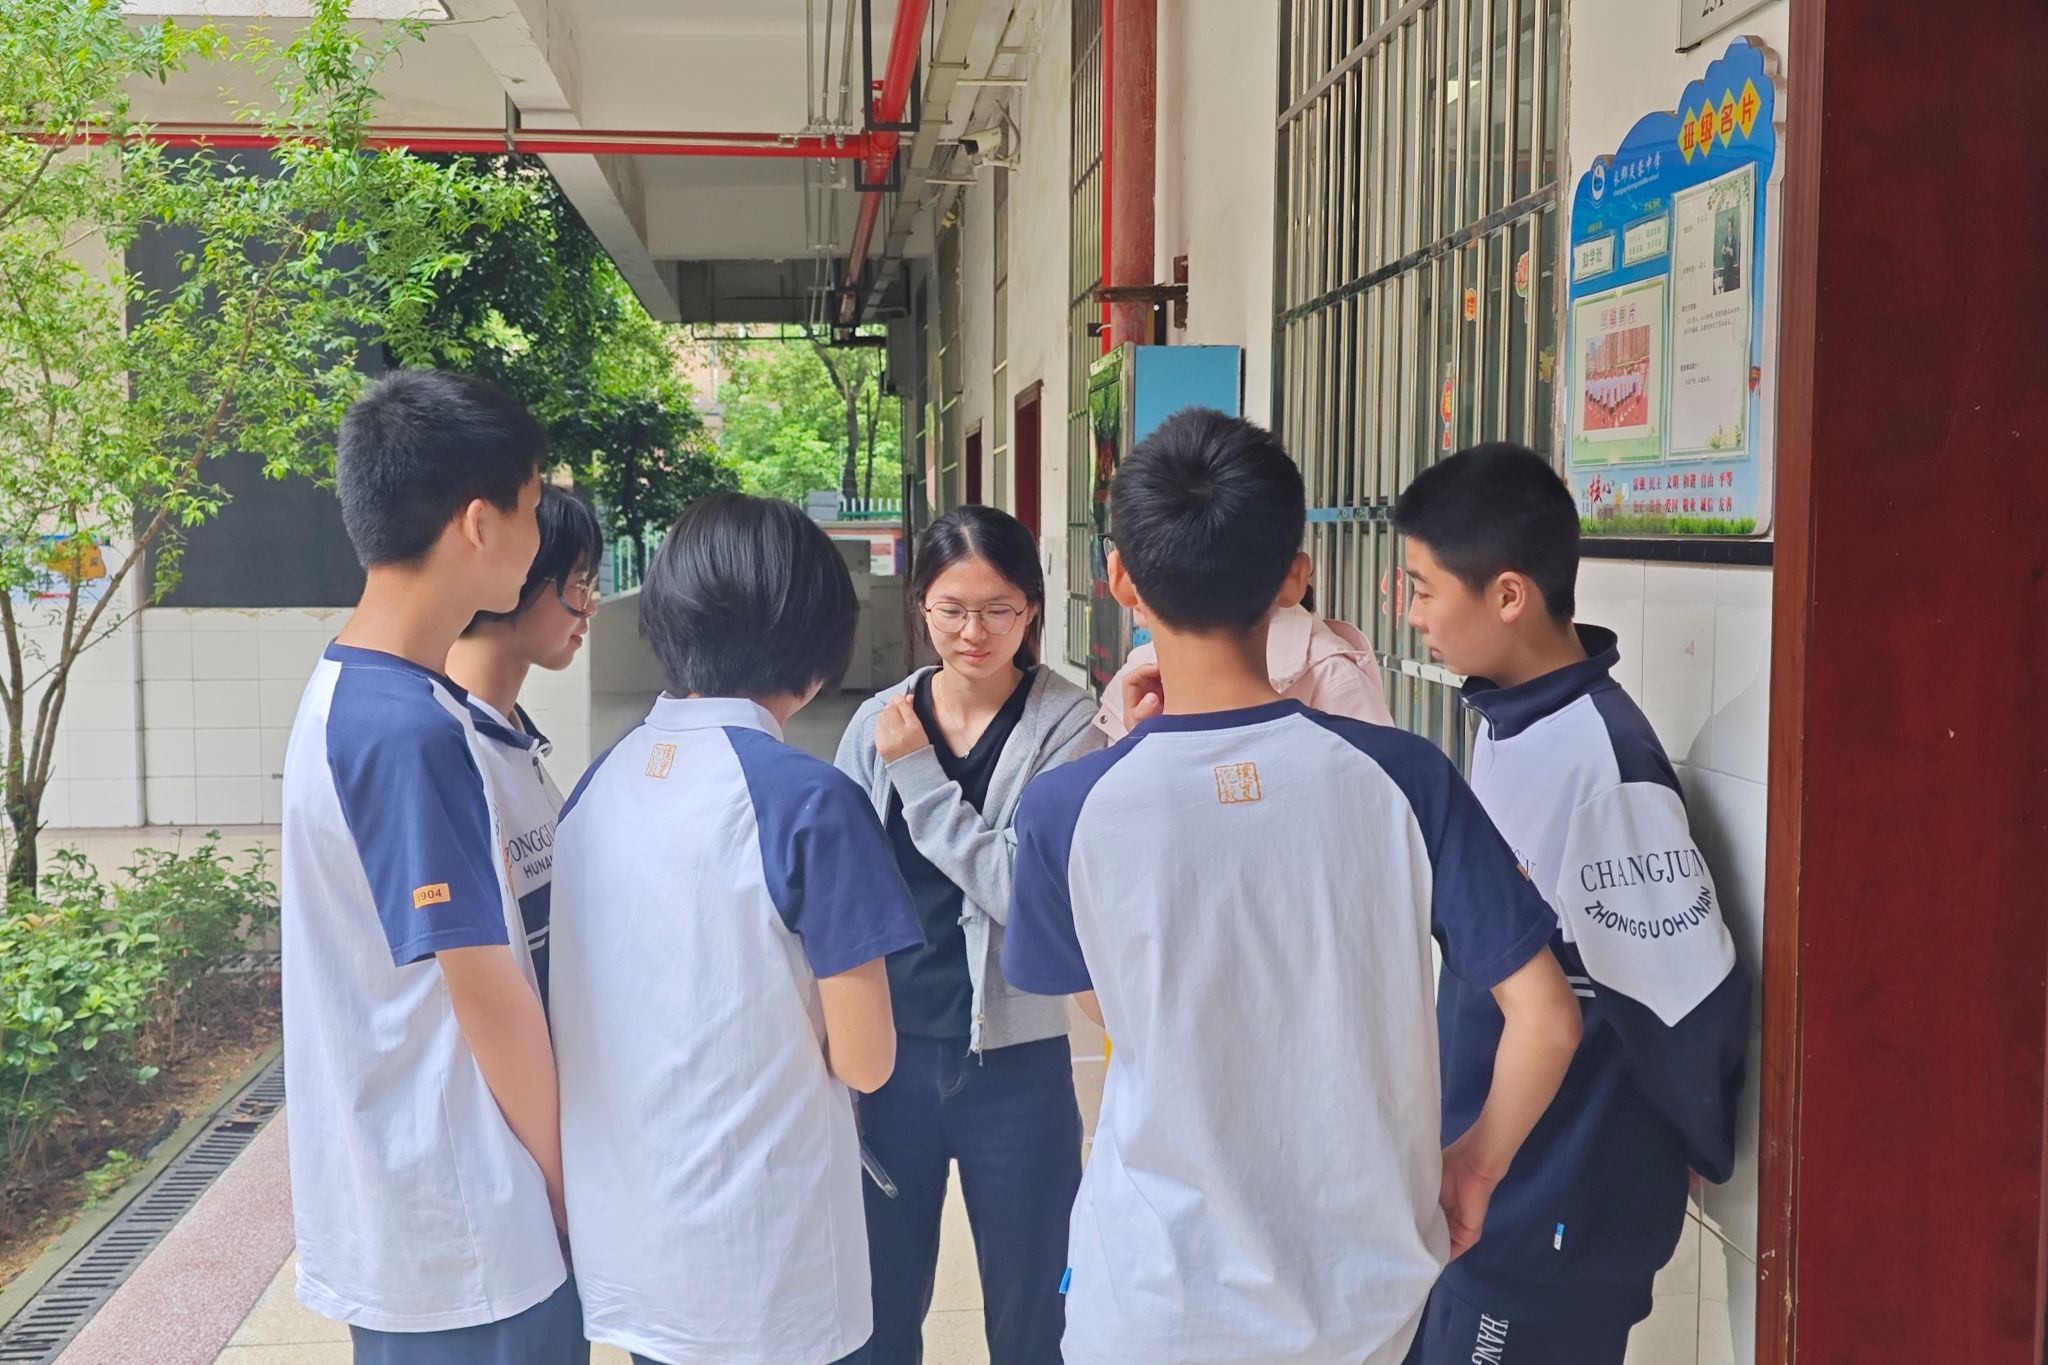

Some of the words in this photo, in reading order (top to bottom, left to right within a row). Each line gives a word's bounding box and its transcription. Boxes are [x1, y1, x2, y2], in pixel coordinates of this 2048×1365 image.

[1683, 93, 1754, 151] 班级名片
[523, 855, 552, 879] HUNA
[1580, 848, 1705, 893] CHANGJUN
[1471, 1313, 1510, 1365] HANG
